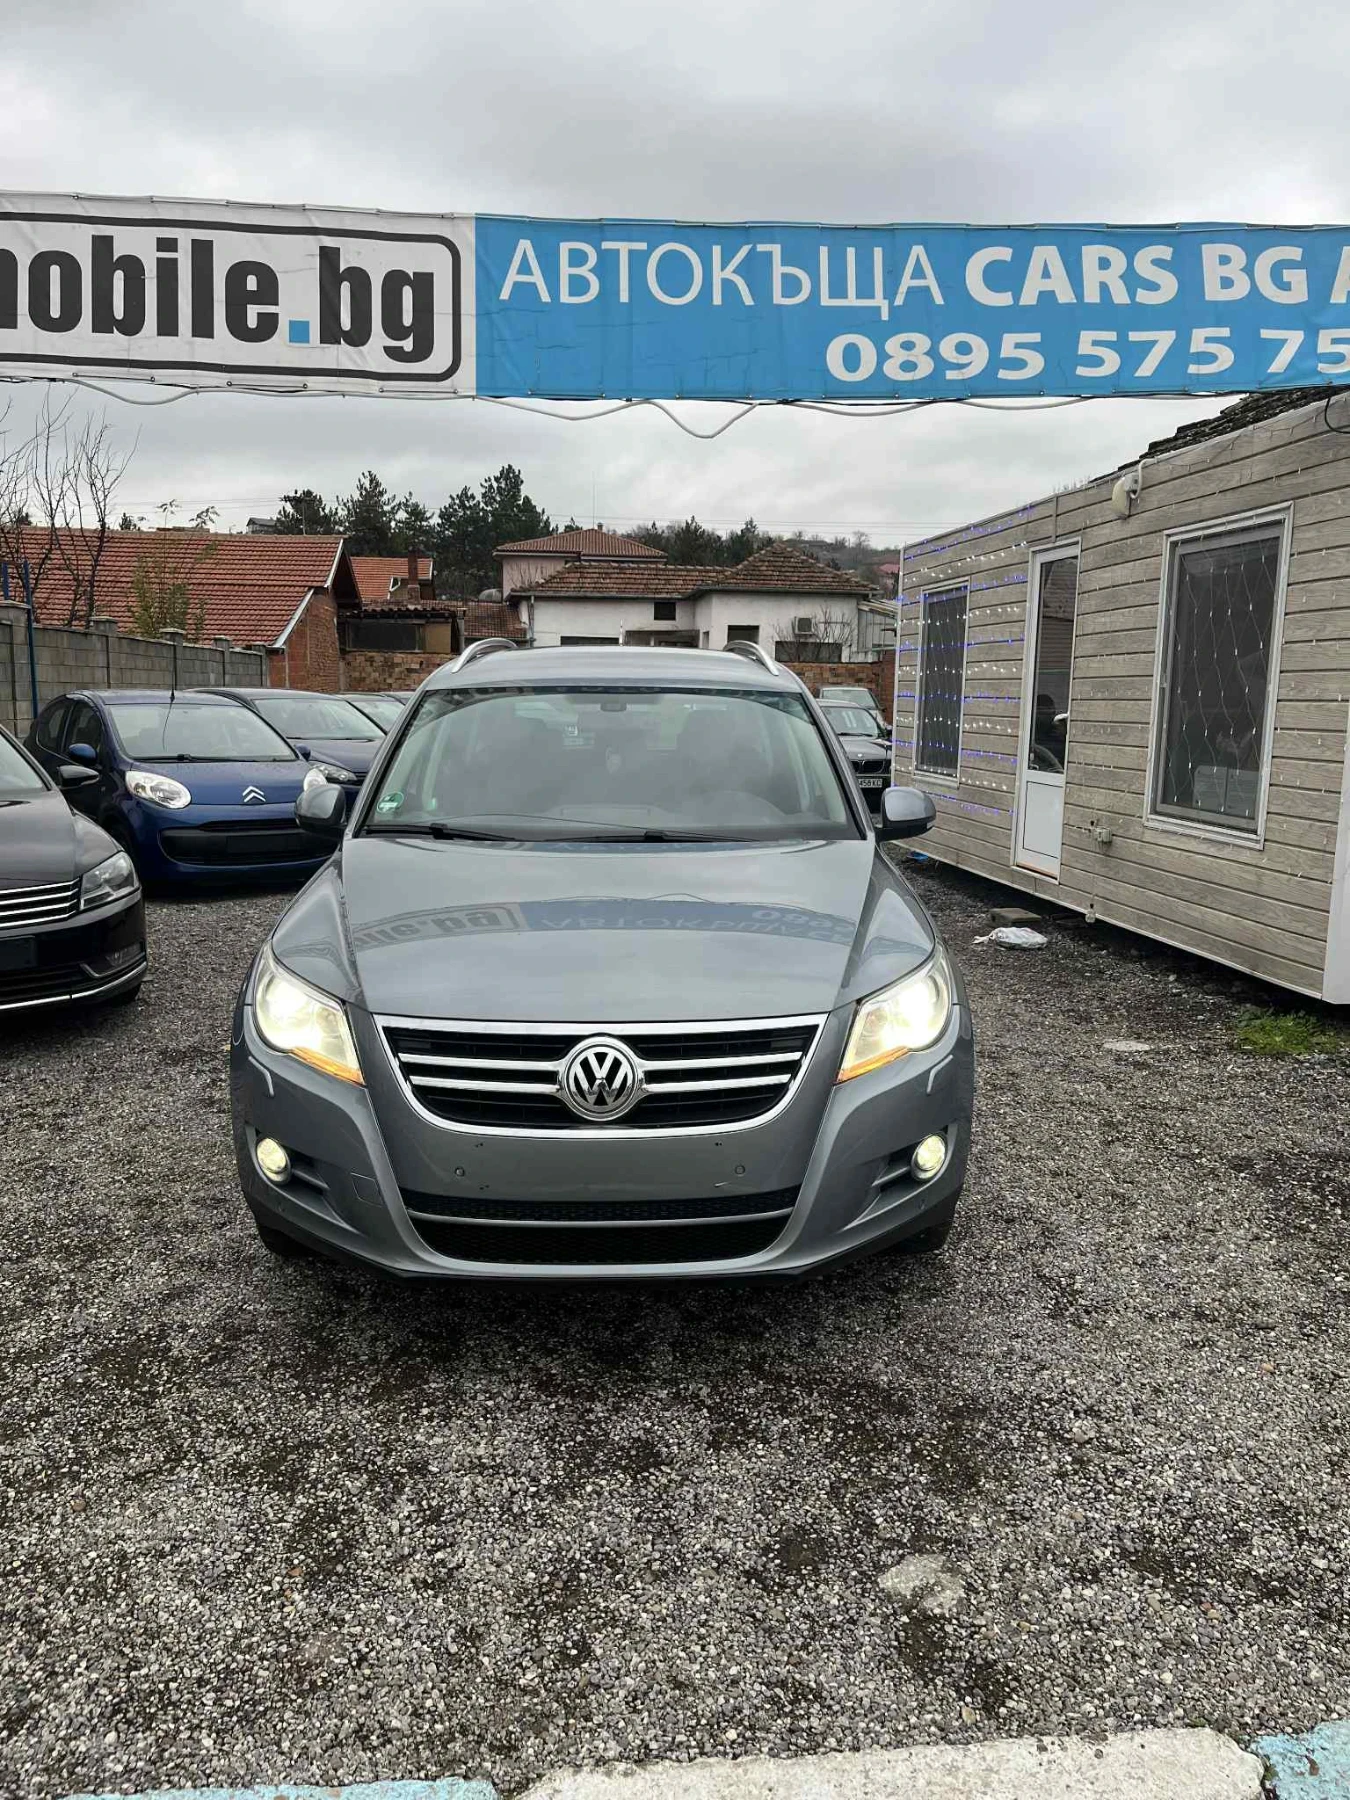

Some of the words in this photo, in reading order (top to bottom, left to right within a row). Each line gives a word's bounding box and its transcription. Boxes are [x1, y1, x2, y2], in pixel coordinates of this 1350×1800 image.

[0, 234, 435, 364] obile.bg
[499, 239, 944, 321] АВТОКЪЩА
[965, 244, 1179, 307] CARS
[1201, 243, 1309, 305] BG
[826, 331, 1045, 382] 0895
[1075, 327, 1235, 377] 575
[569, 1046, 633, 1111] VW
